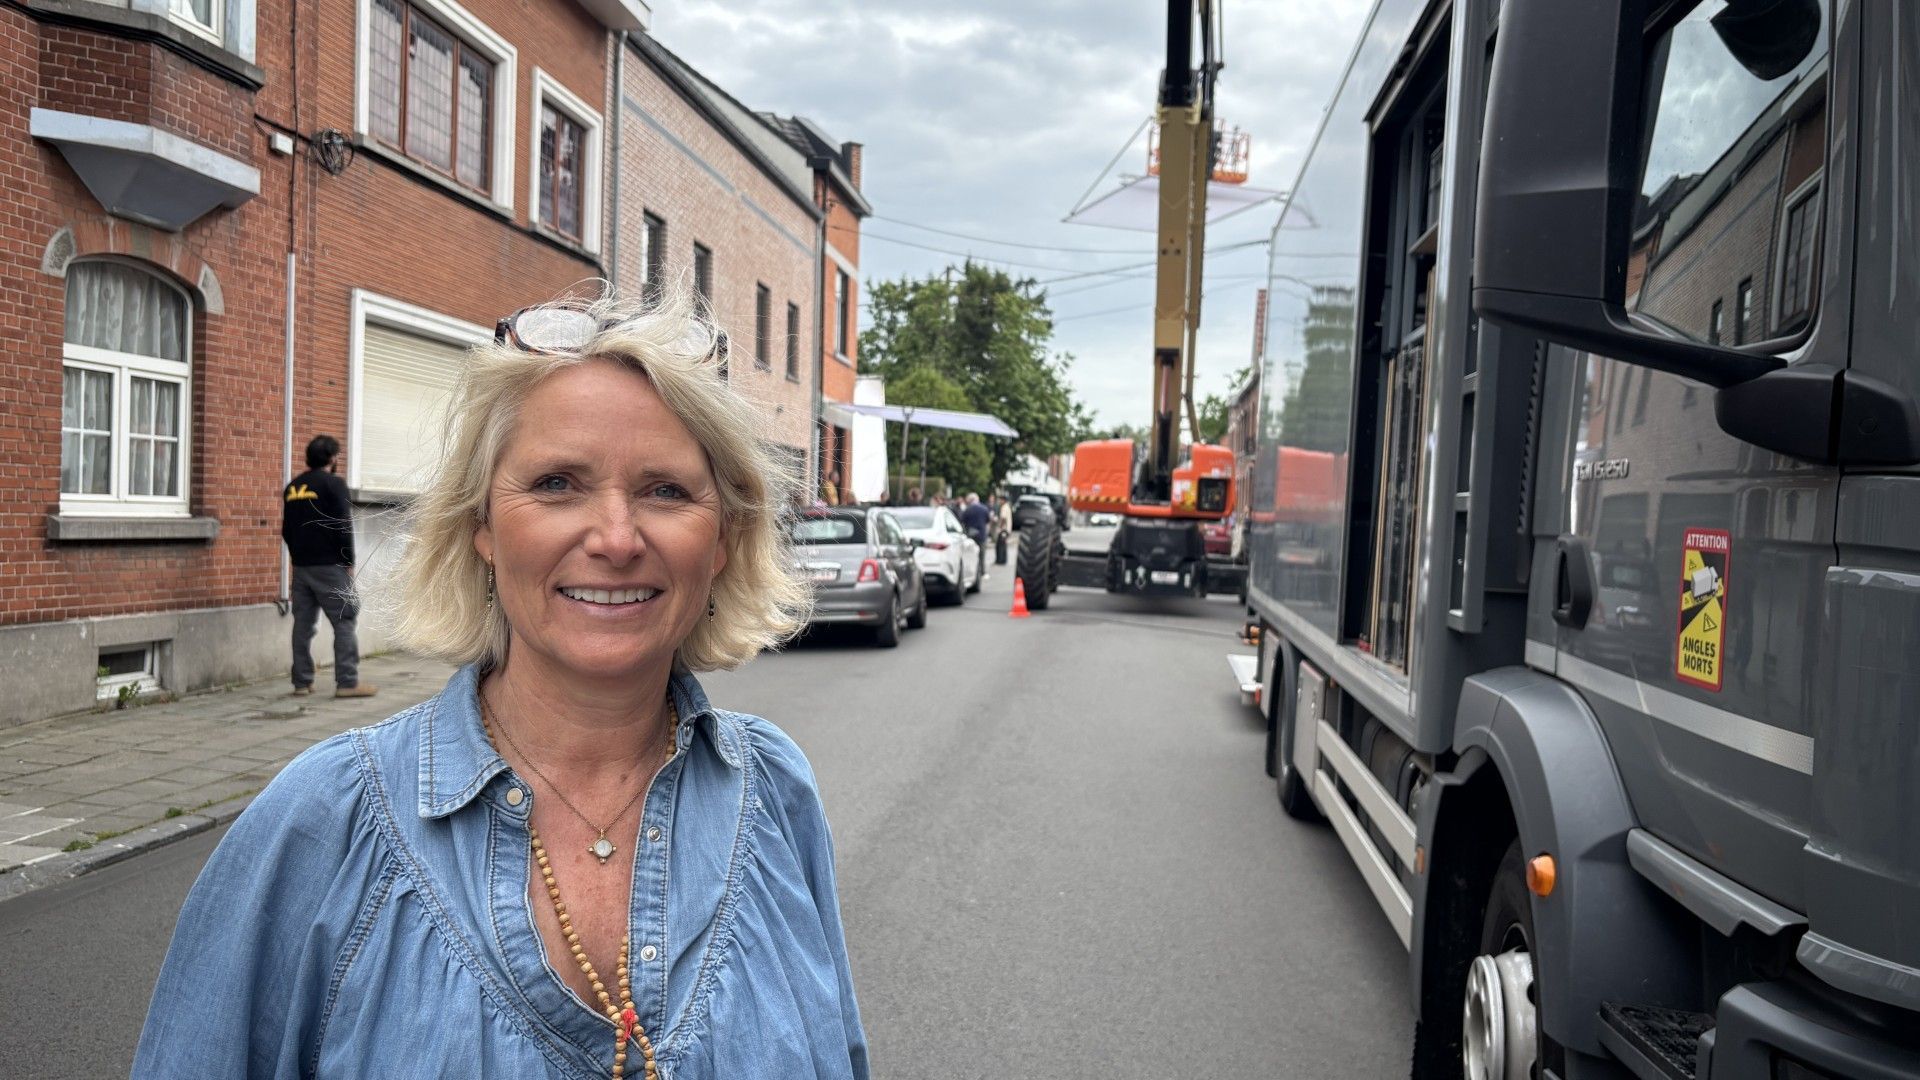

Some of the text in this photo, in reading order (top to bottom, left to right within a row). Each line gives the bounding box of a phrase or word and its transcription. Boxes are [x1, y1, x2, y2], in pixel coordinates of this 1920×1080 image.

[1685, 533, 1728, 550] ATTENTION
[1682, 636, 1716, 658] ANGLES
[1683, 654, 1713, 675] MORTS
